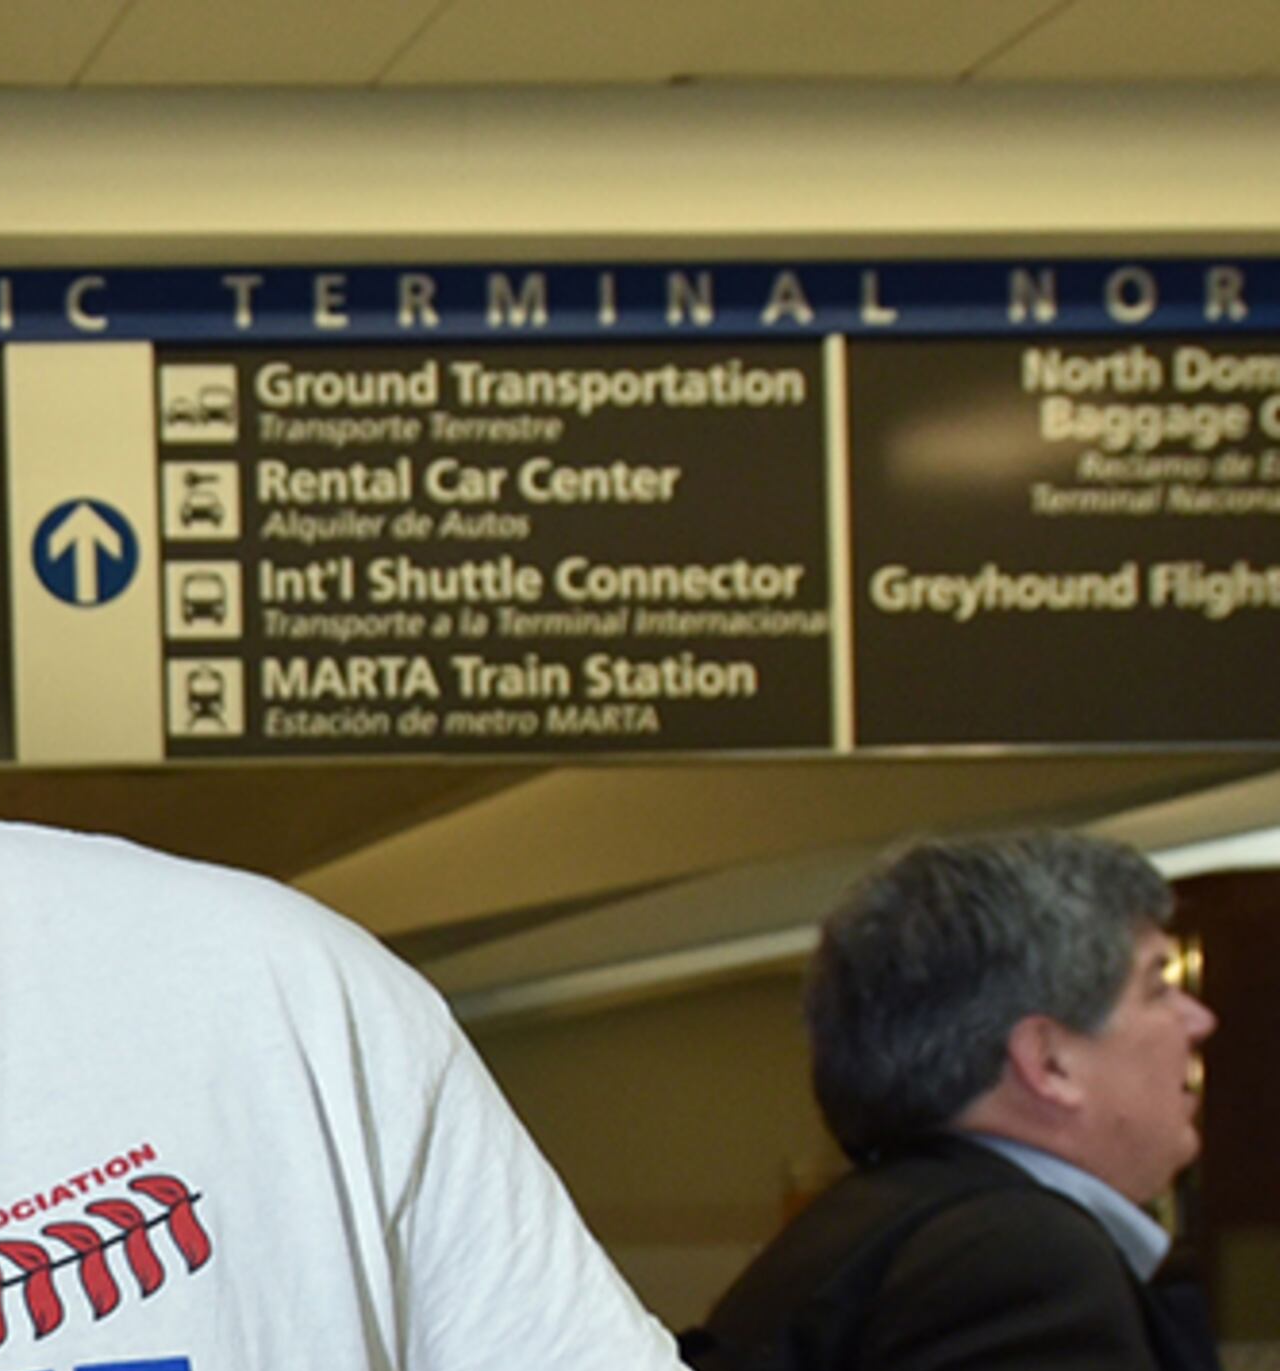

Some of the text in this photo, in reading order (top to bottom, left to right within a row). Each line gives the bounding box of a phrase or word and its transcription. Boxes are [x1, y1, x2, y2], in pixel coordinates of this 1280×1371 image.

[222, 268, 898, 330] TERMINAL
[1006, 265, 1248, 325] NOR
[255, 356, 806, 416] Ground Transportation
[1021, 346, 1163, 392] North
[257, 411, 563, 447] Transporte Terrestre
[1040, 395, 1251, 451] Baggage
[257, 456, 681, 503] Rental Car Center
[261, 508, 531, 546] Alquiler de Autos
[259, 555, 805, 602] Int'l Shuttle Connector
[869, 561, 1139, 622] Greyhound
[263, 605, 832, 644] Transporte a la Terminal Internaciona
[261, 651, 757, 699] MARTA Train Station
[264, 703, 661, 739] Estación de metro MARTA
